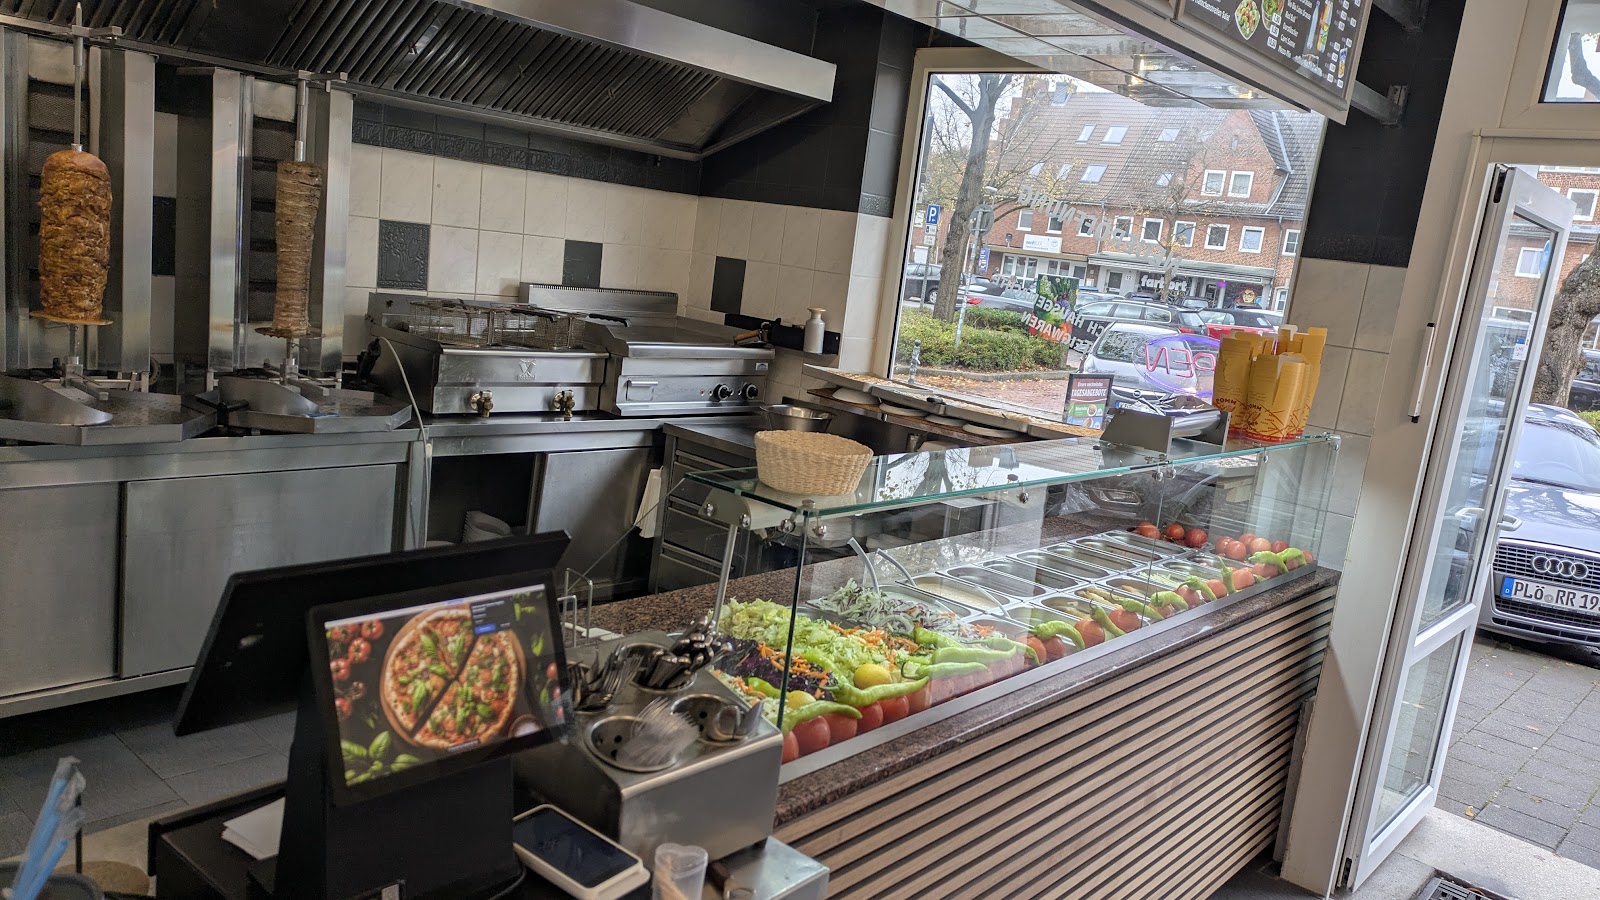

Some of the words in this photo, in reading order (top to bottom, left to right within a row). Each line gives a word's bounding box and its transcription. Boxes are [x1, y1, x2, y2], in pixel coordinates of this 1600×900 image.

[929, 207, 937, 222] P
[1072, 389, 1107, 397] TAGESANGEBOTE
[1513, 581, 1545, 600] PLÖ
[1556, 589, 1577, 607] RR
[1579, 594, 1600, 610] 19
